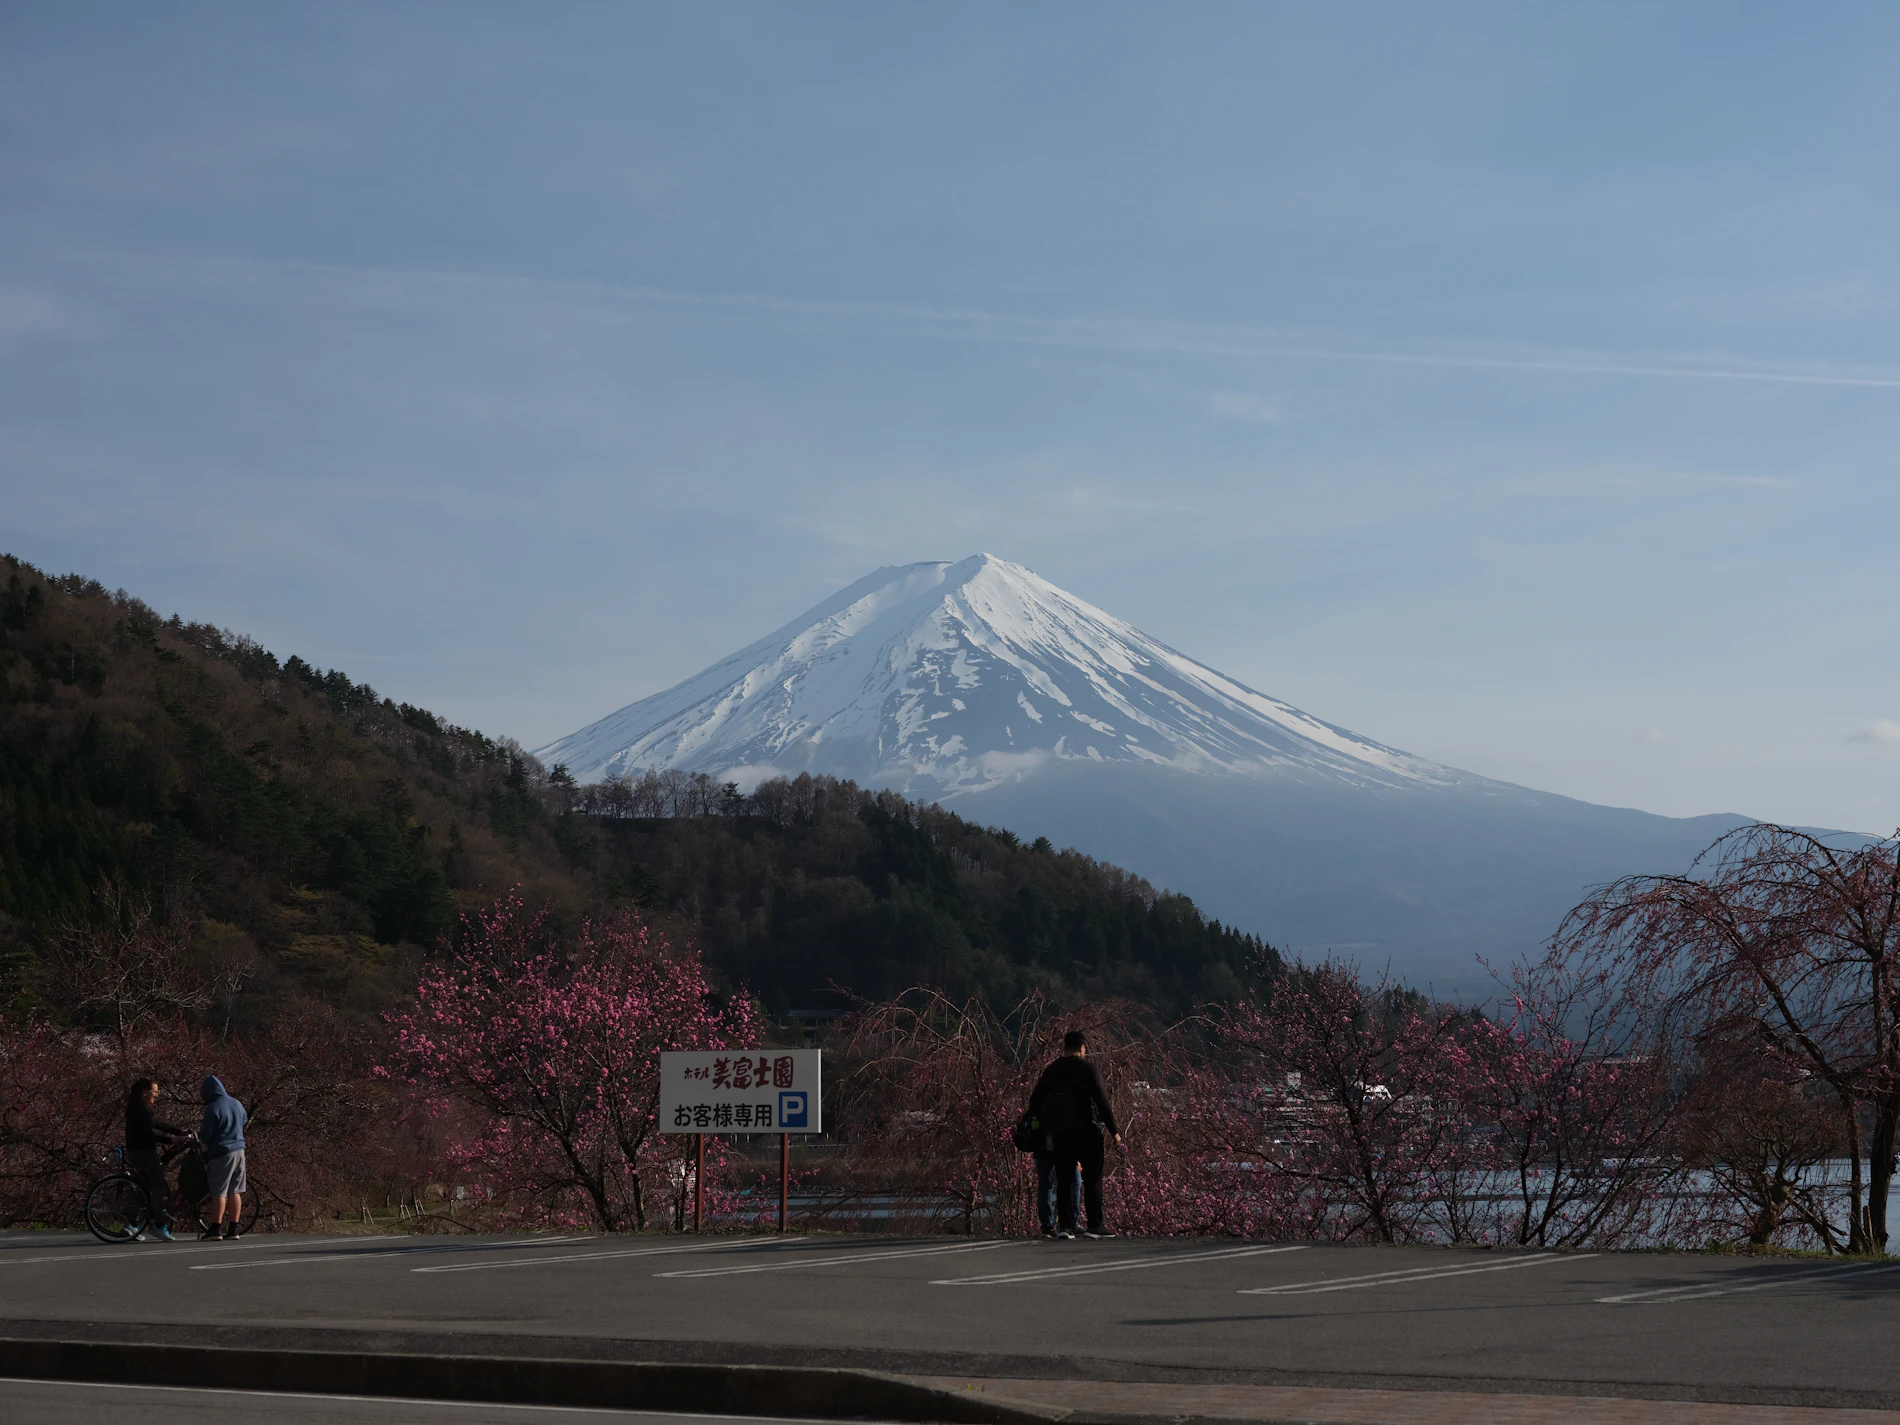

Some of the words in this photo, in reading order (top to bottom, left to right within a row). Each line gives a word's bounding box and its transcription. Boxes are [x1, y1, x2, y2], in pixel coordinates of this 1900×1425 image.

[684, 1067, 710, 1081] ホテル
[712, 1056, 794, 1090] 美富士園
[674, 1103, 772, 1127] お客様専用
[782, 1096, 804, 1123] P
